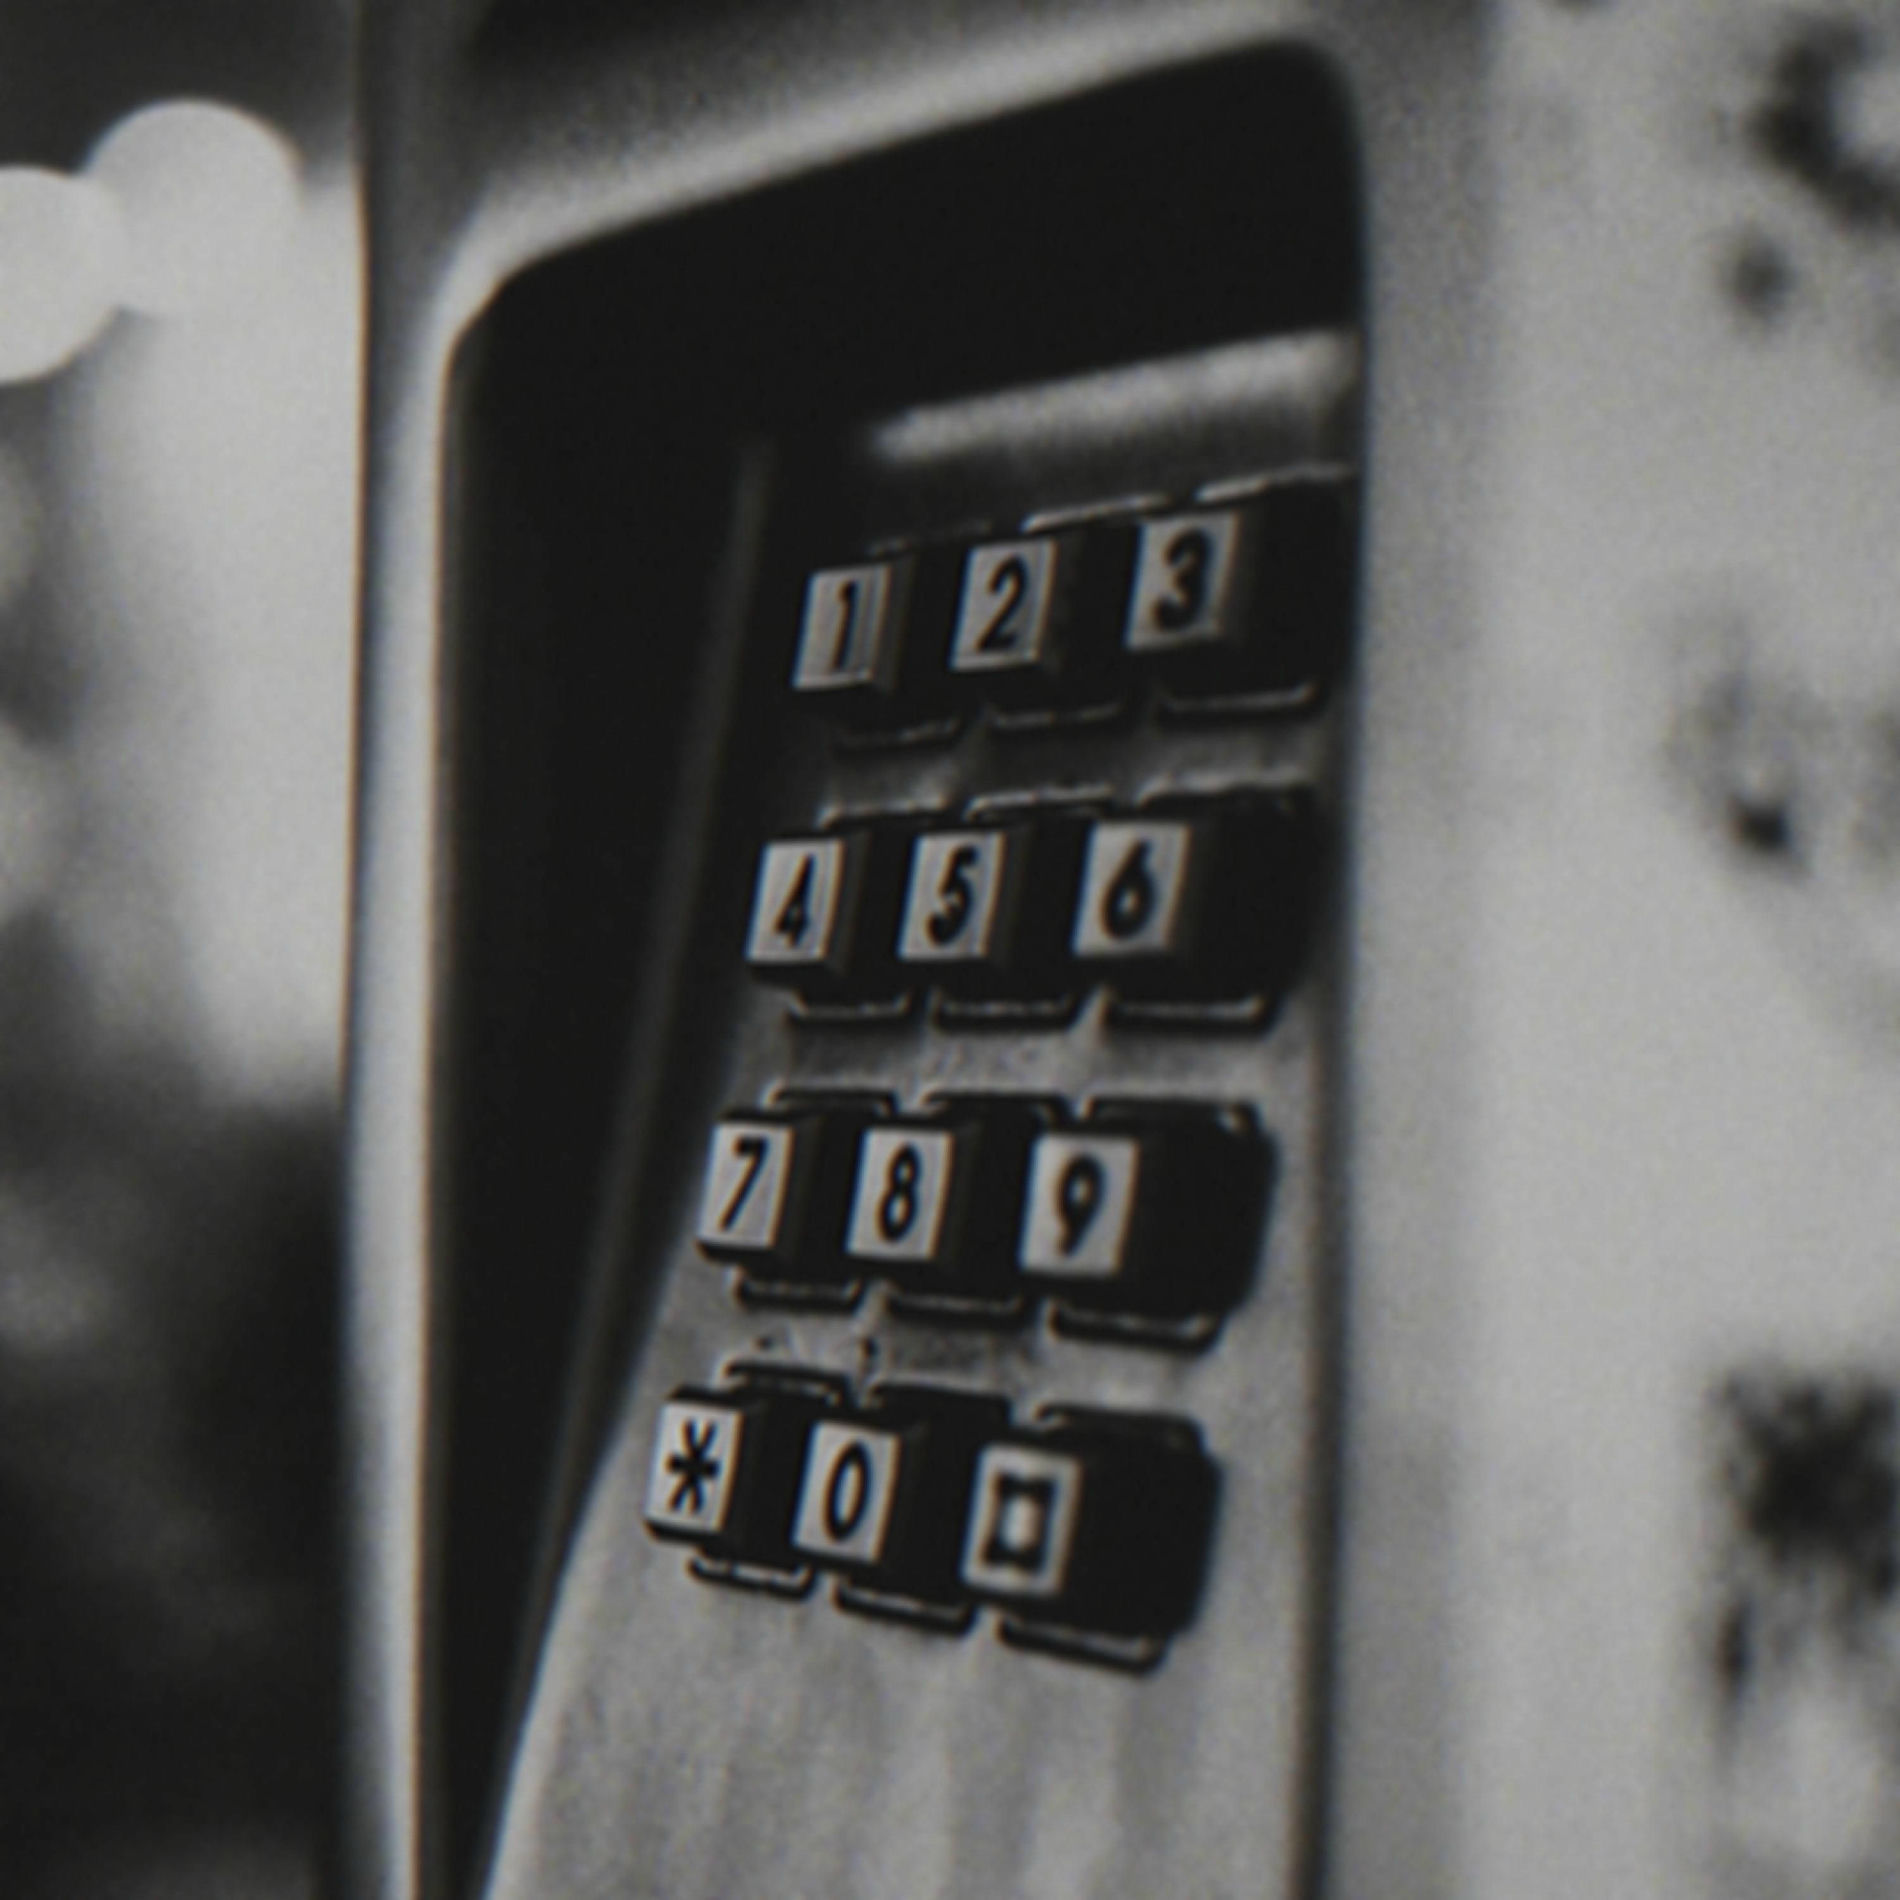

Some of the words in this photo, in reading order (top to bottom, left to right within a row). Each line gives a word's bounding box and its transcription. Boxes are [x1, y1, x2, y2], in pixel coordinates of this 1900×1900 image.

[831, 580, 860, 671] 1
[975, 554, 1029, 653] 2
[1151, 528, 1214, 632] 3
[774, 853, 815, 948] 4
[925, 845, 979, 946] 5
[1102, 839, 1155, 940] 6
[720, 1136, 771, 1232] 7
[876, 1143, 922, 1243] 8
[1057, 1152, 1107, 1257] 9
[822, 1439, 873, 1542] 0
